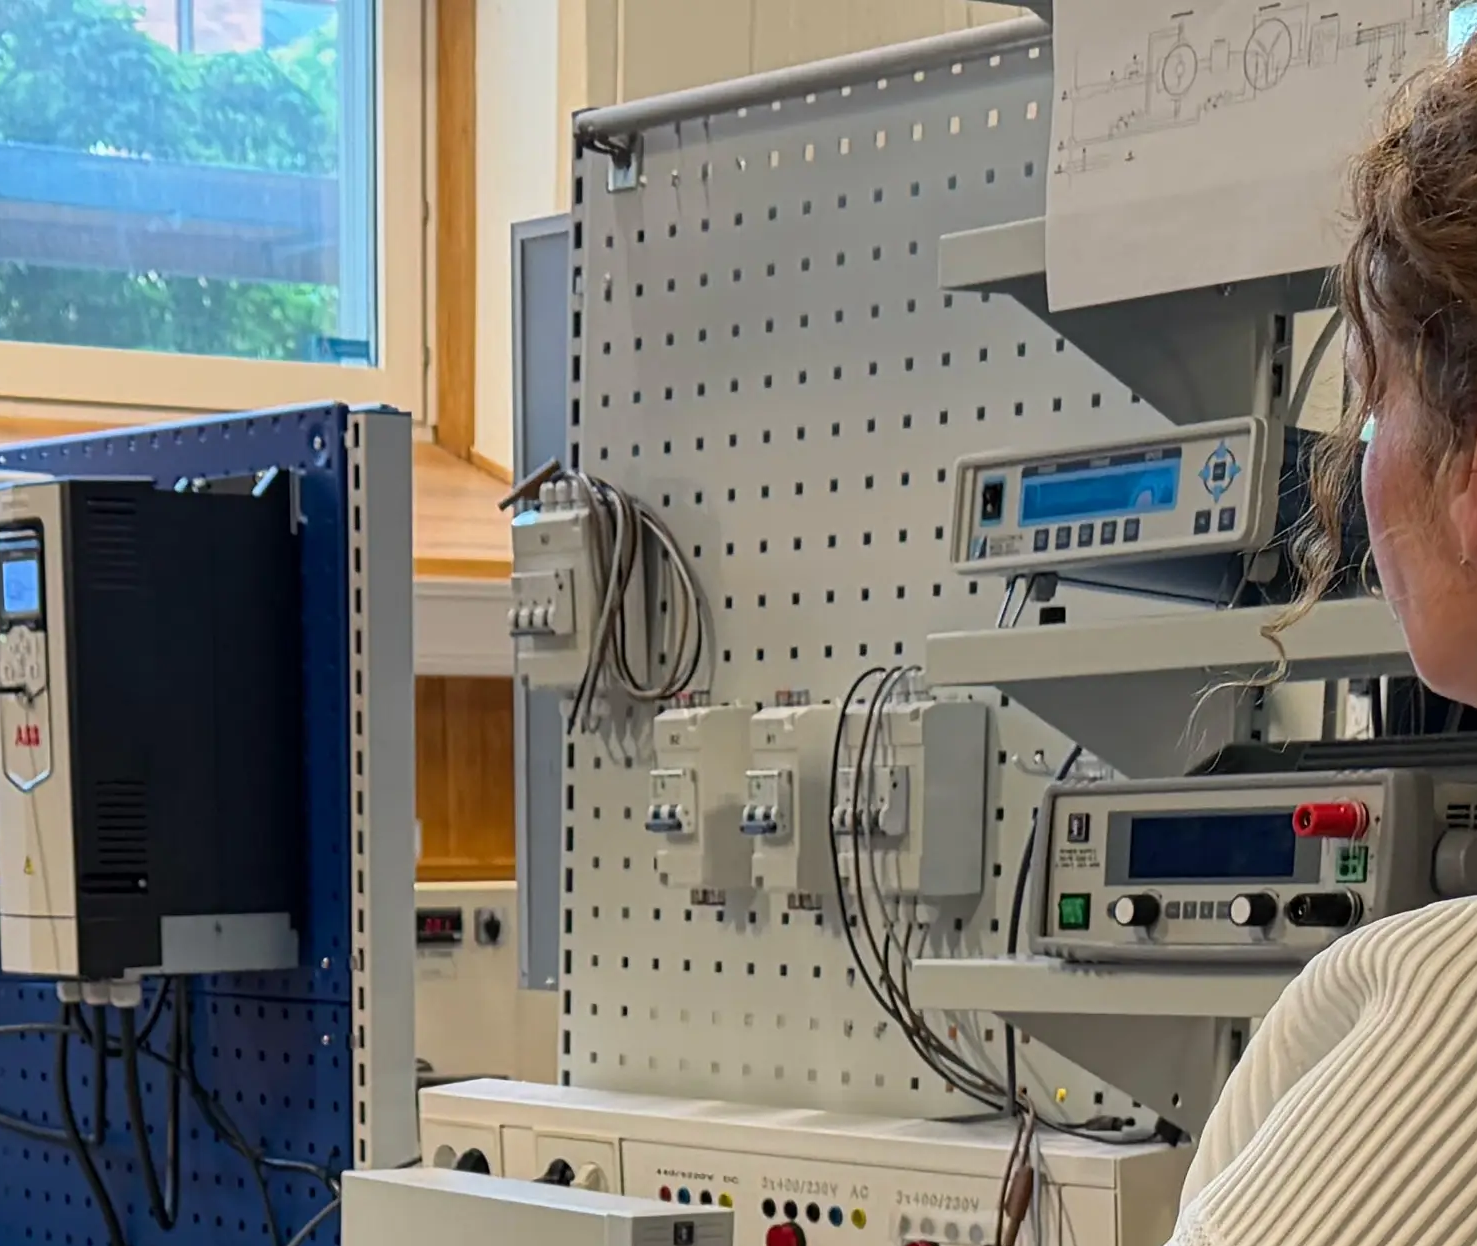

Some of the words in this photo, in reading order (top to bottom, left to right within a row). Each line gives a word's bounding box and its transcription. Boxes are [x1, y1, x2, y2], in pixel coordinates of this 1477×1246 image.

[15, 724, 40, 747] ABB
[849, 1183, 869, 1200] AC
[895, 1189, 980, 1213] 3x400/230V
